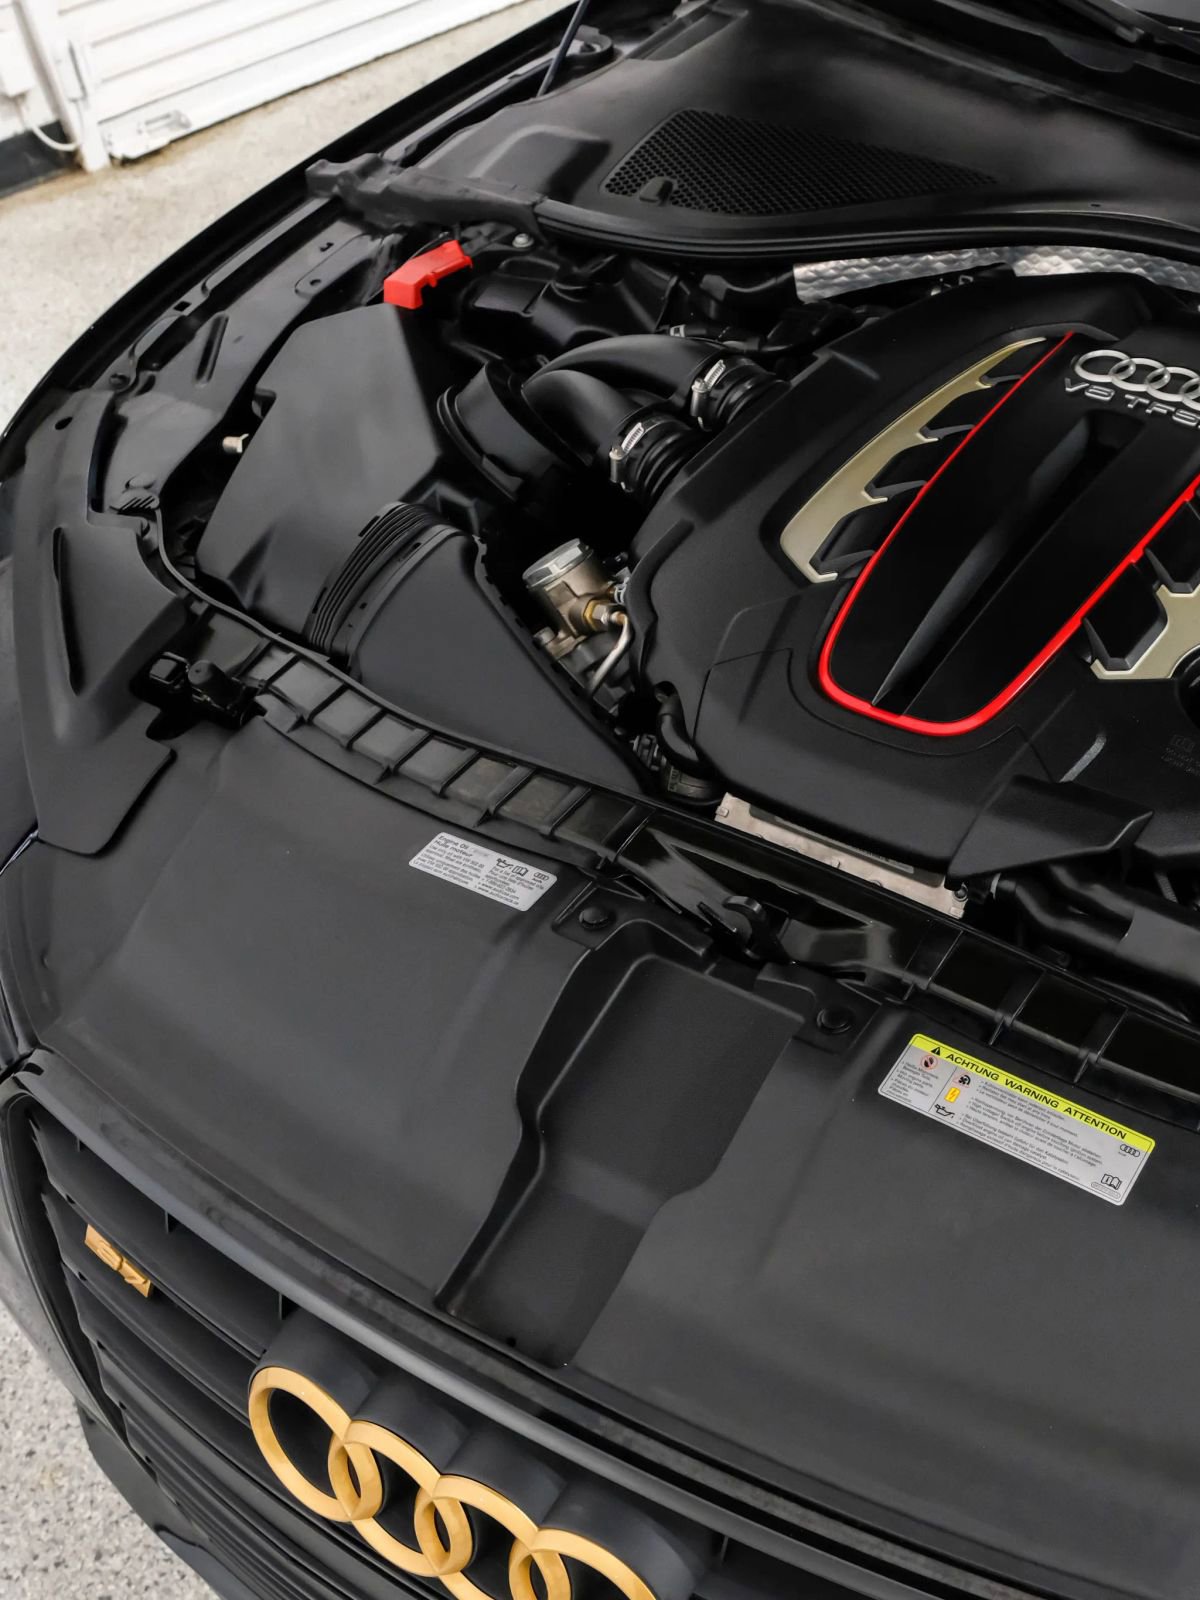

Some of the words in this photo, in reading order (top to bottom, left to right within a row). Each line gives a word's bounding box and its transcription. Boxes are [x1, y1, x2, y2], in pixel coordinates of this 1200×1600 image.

[1064, 377, 1116, 401] V8
[945, 1053, 1000, 1081] ACHTUNG
[1004, 1078, 1059, 1108] WARNING
[1063, 1106, 1127, 1140] ATTENTION
[93, 1234, 151, 1298] S7
